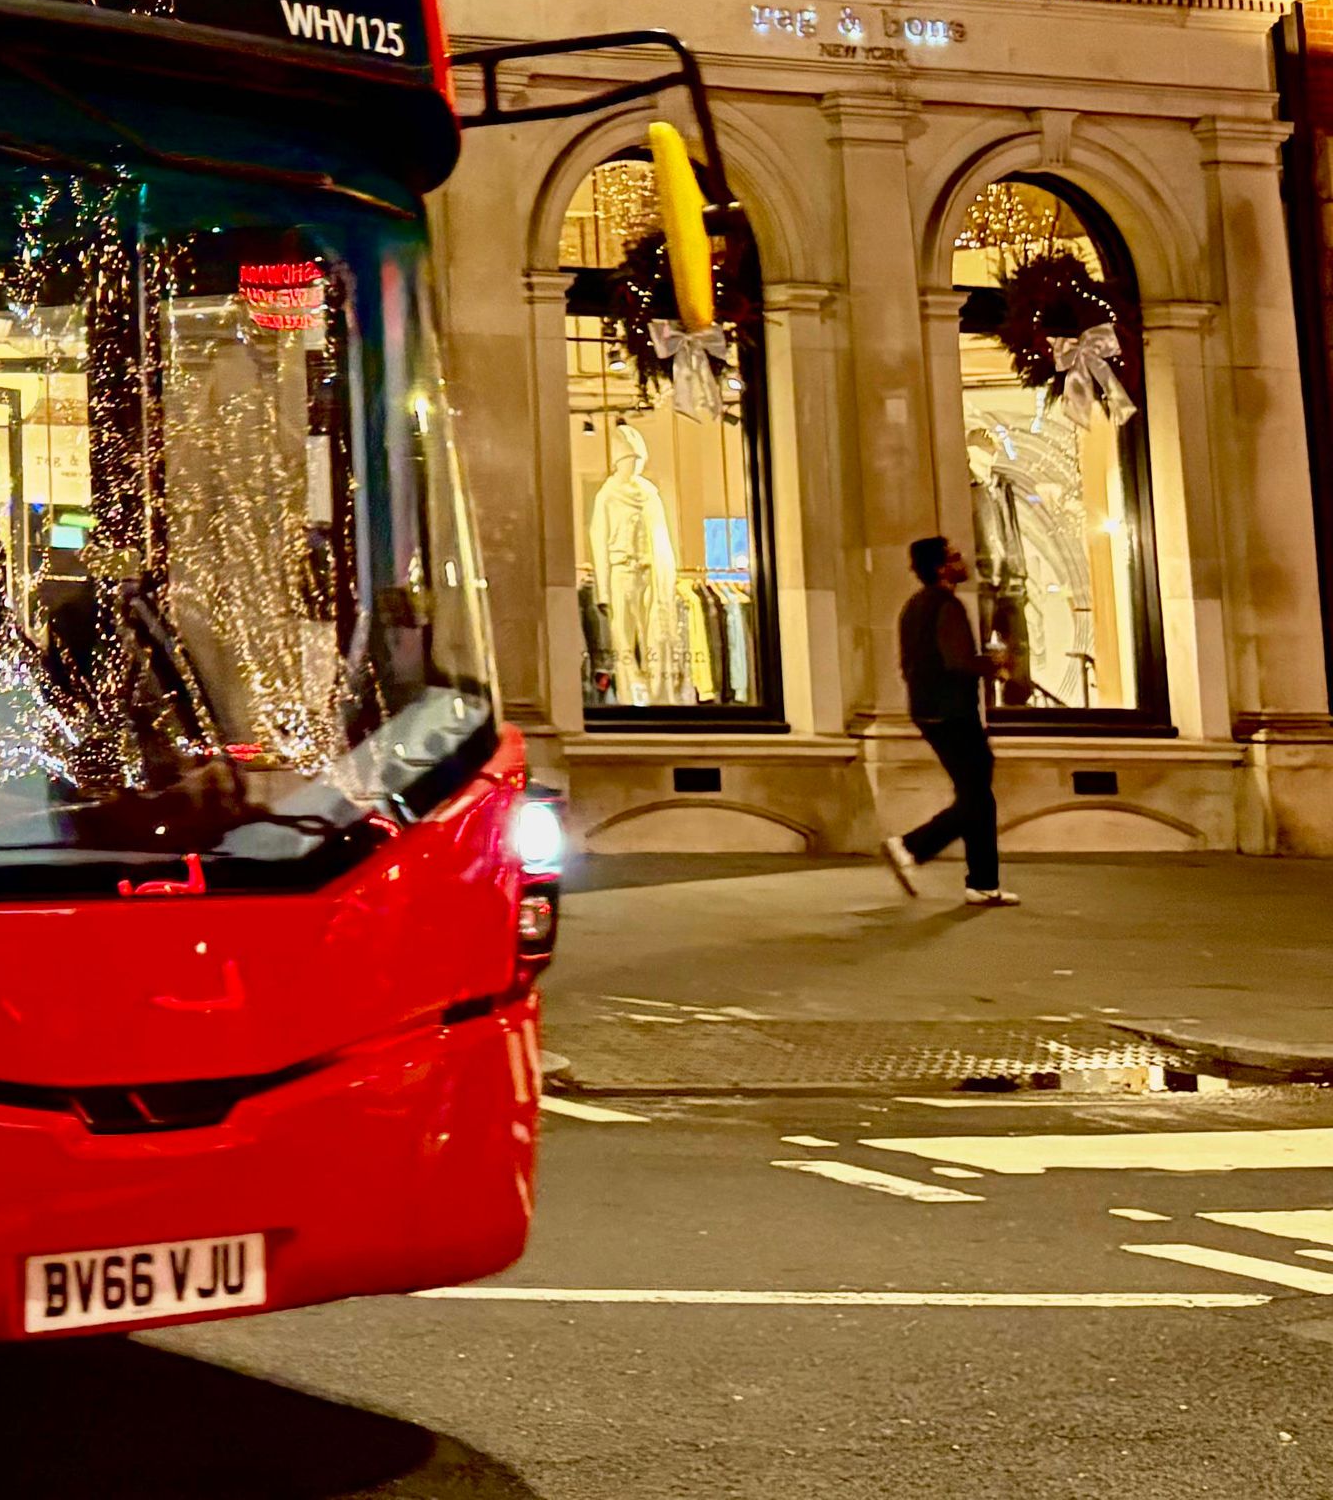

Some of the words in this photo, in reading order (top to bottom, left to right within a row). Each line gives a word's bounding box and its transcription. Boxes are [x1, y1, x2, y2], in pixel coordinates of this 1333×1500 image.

[279, 0, 405, 57] WHV125
[751, 4, 817, 37] rag
[837, 6, 863, 39] &
[881, 9, 967, 44] bone
[818, 42, 857, 60] NEW
[862, 46, 910, 63] YORK
[43, 1252, 154, 1318] BV66
[169, 1241, 246, 1302] VJU
